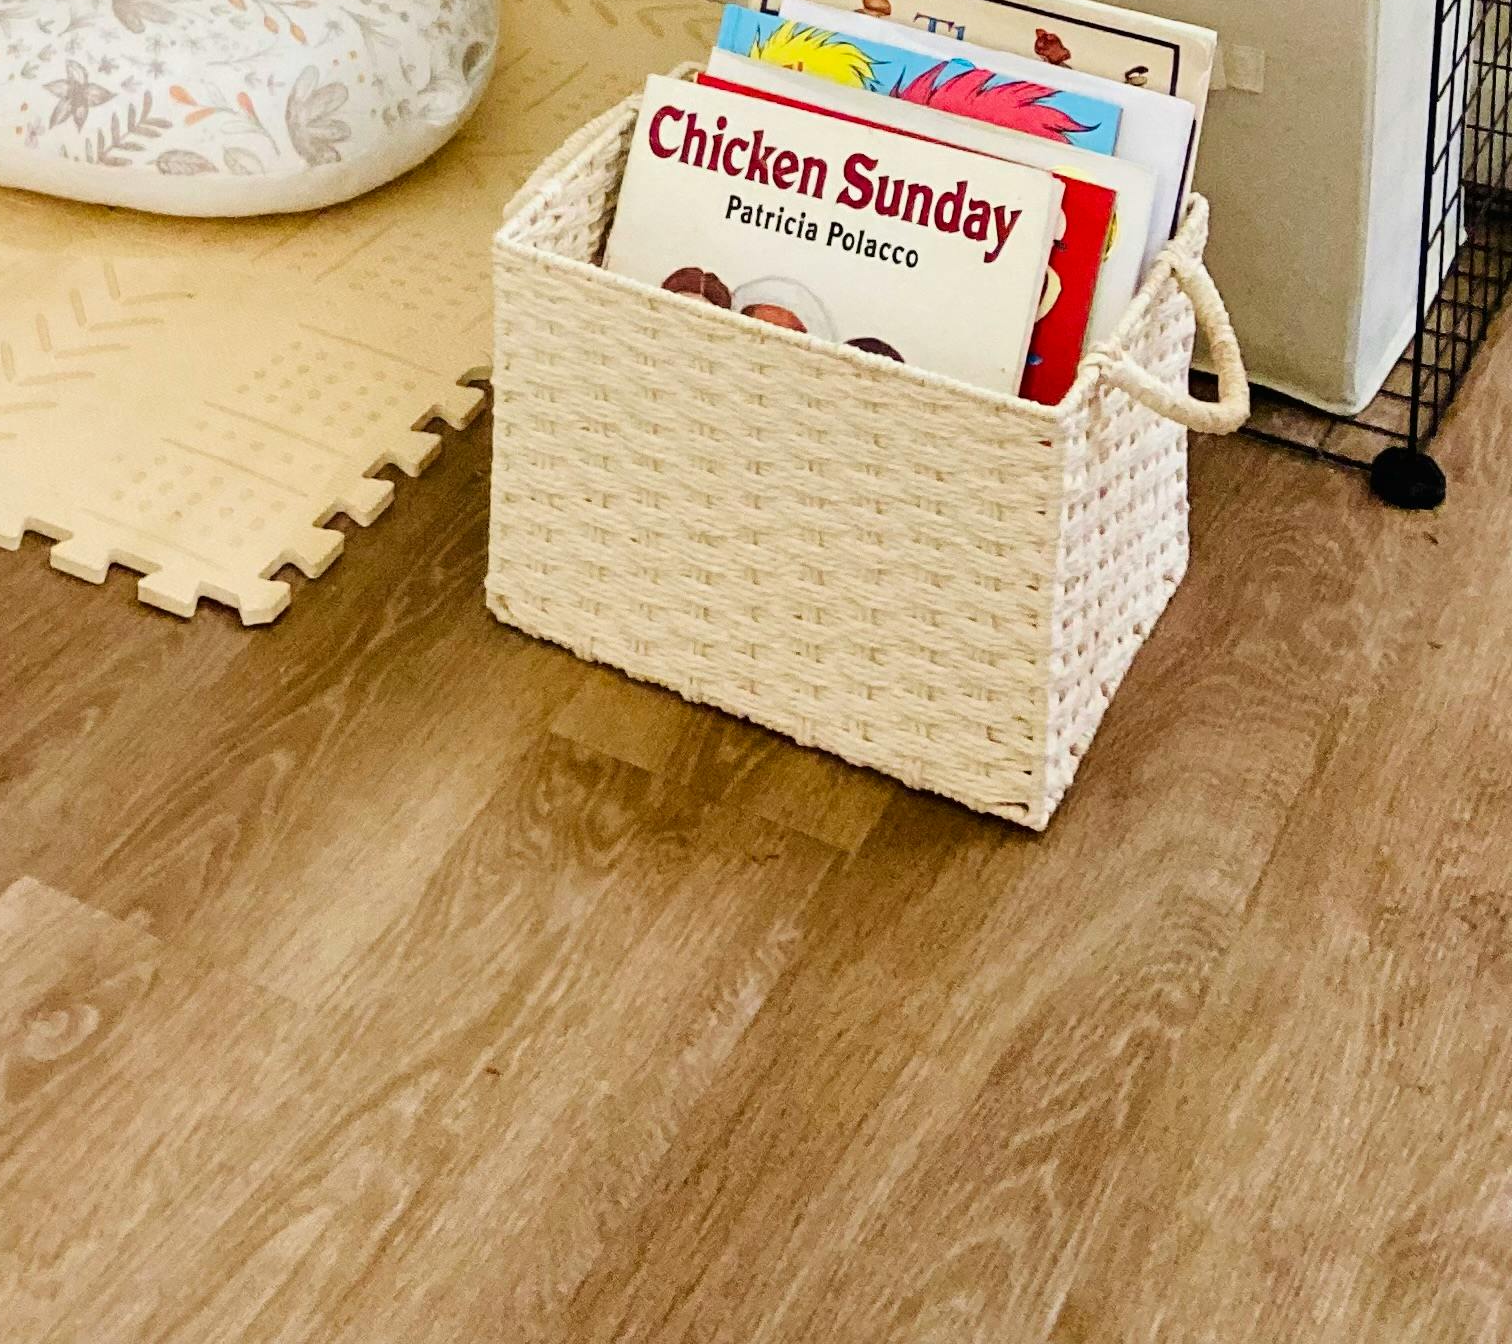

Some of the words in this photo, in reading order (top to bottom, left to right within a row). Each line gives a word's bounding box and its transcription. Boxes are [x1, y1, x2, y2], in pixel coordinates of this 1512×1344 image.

[648, 105, 828, 199] Chicken
[836, 152, 1023, 263] Sunday
[725, 194, 818, 241] Patricia
[826, 221, 919, 269] Polacco
